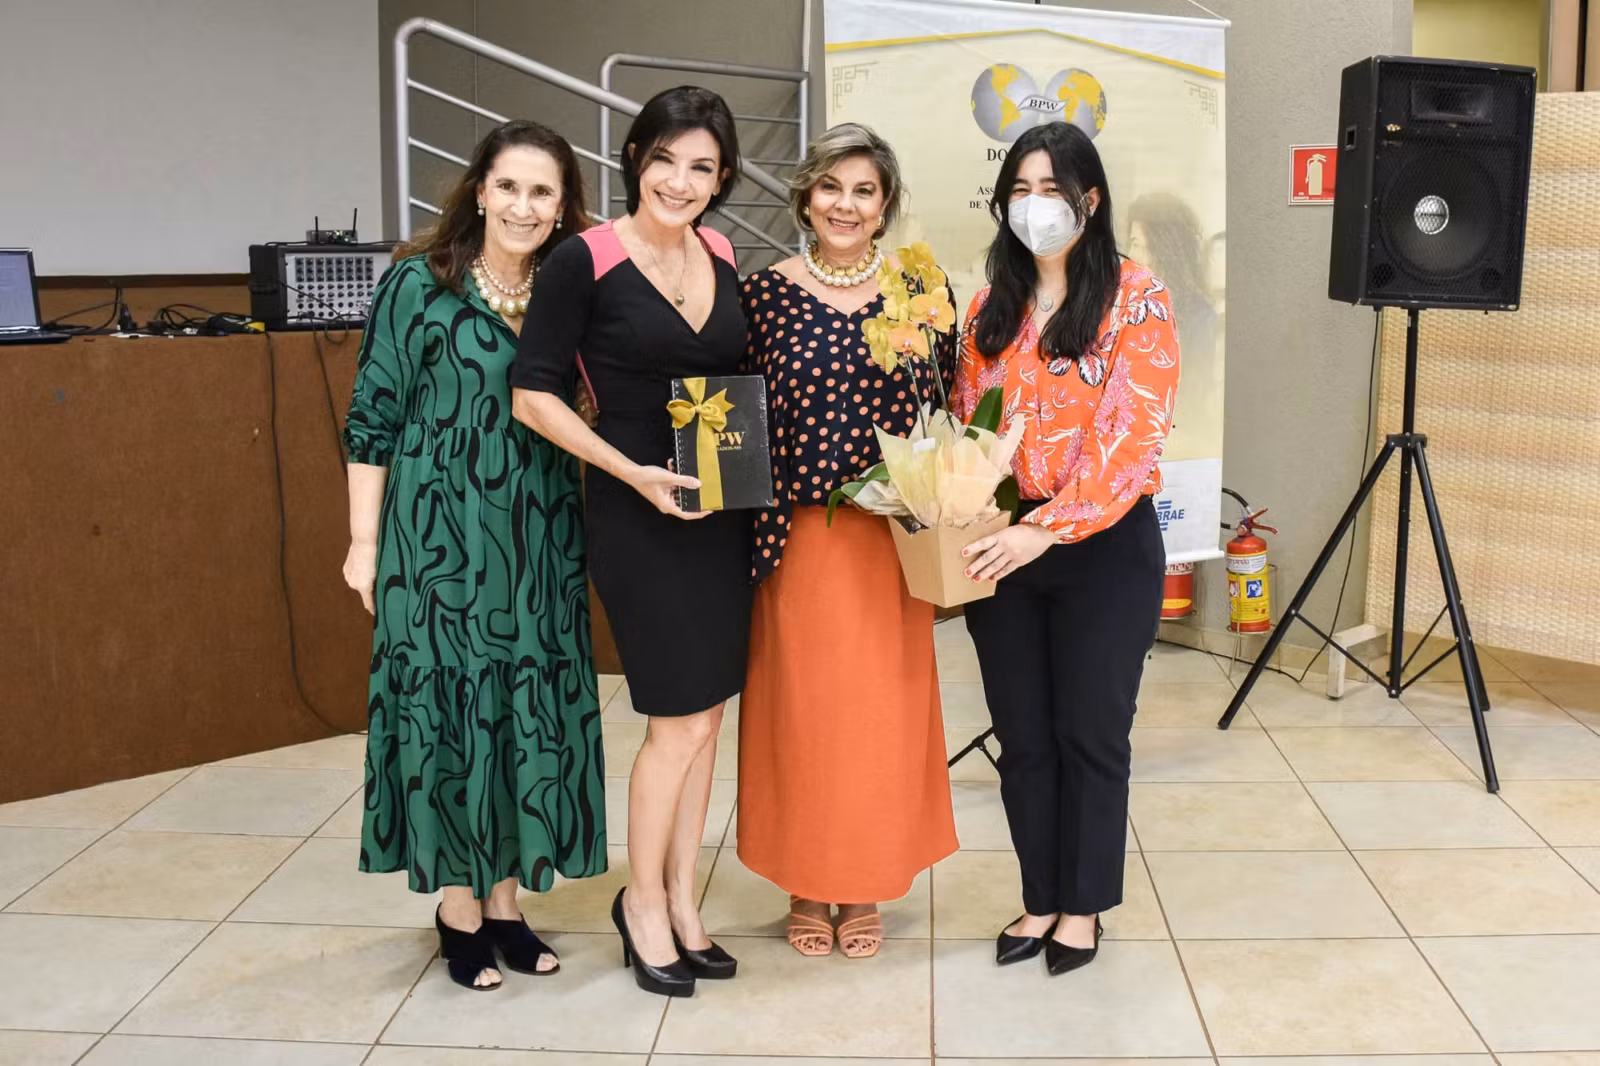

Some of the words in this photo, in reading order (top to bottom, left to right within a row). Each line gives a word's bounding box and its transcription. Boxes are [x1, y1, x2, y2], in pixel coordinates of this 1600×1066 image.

[1029, 98, 1058, 110] BPW
[987, 148, 1009, 161] DO
[714, 431, 745, 445] PW
[1156, 509, 1184, 520] BRAE
